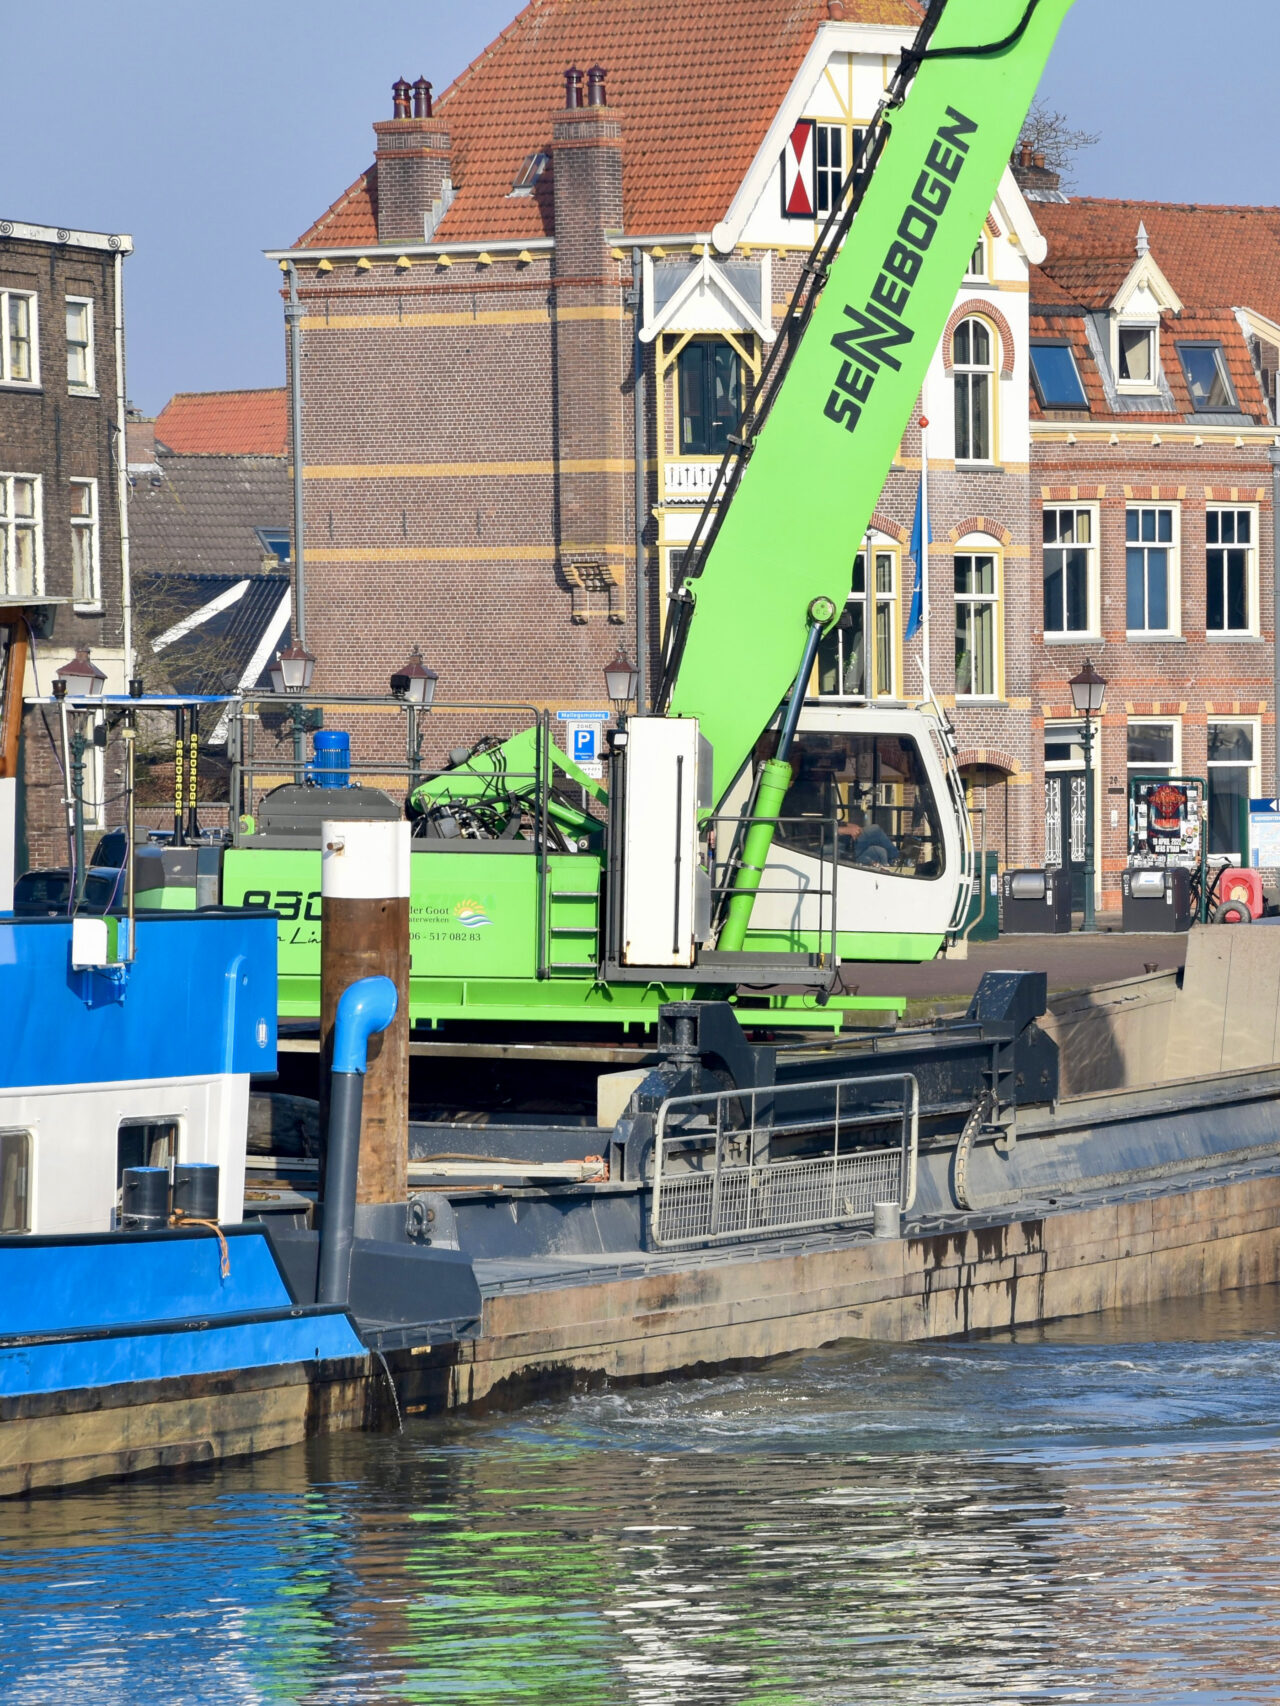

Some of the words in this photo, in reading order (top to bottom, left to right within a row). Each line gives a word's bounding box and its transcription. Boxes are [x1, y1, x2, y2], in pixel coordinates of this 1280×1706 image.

[823, 105, 979, 433] SENNEBOGEN
[577, 731, 590, 748] P
[175, 740, 183, 816] GEODREDGE
[190, 734, 198, 808] GEODREDGE
[425, 906, 449, 915] Goot
[429, 932, 447, 941] 517
[449, 932, 467, 941] 082
[469, 932, 481, 941] 83
